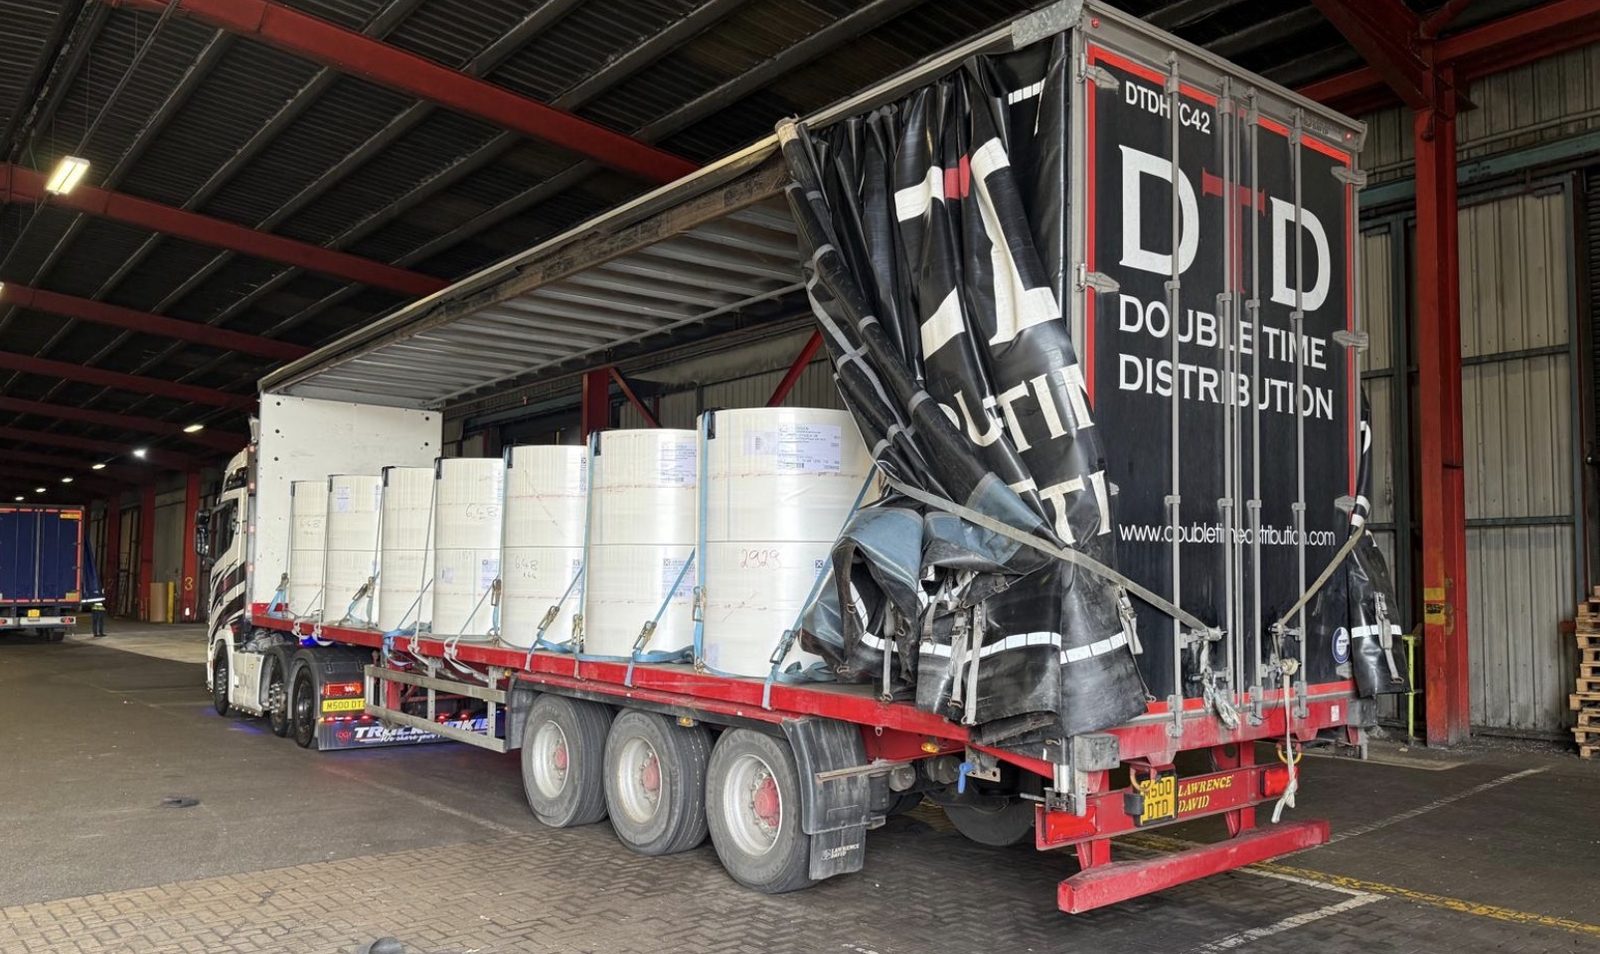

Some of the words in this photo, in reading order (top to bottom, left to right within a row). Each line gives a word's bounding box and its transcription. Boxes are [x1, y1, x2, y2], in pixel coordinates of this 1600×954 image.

[1125, 80, 1211, 135] DTDHC42
[1262, 324, 1327, 370] TIME
[184, 576, 194, 592] 3
[326, 701, 350, 710] M500
[1178, 777, 1233, 797] LAWRENCE
[1147, 798, 1169, 819] DTD
[1178, 796, 1210, 813] DAVID
